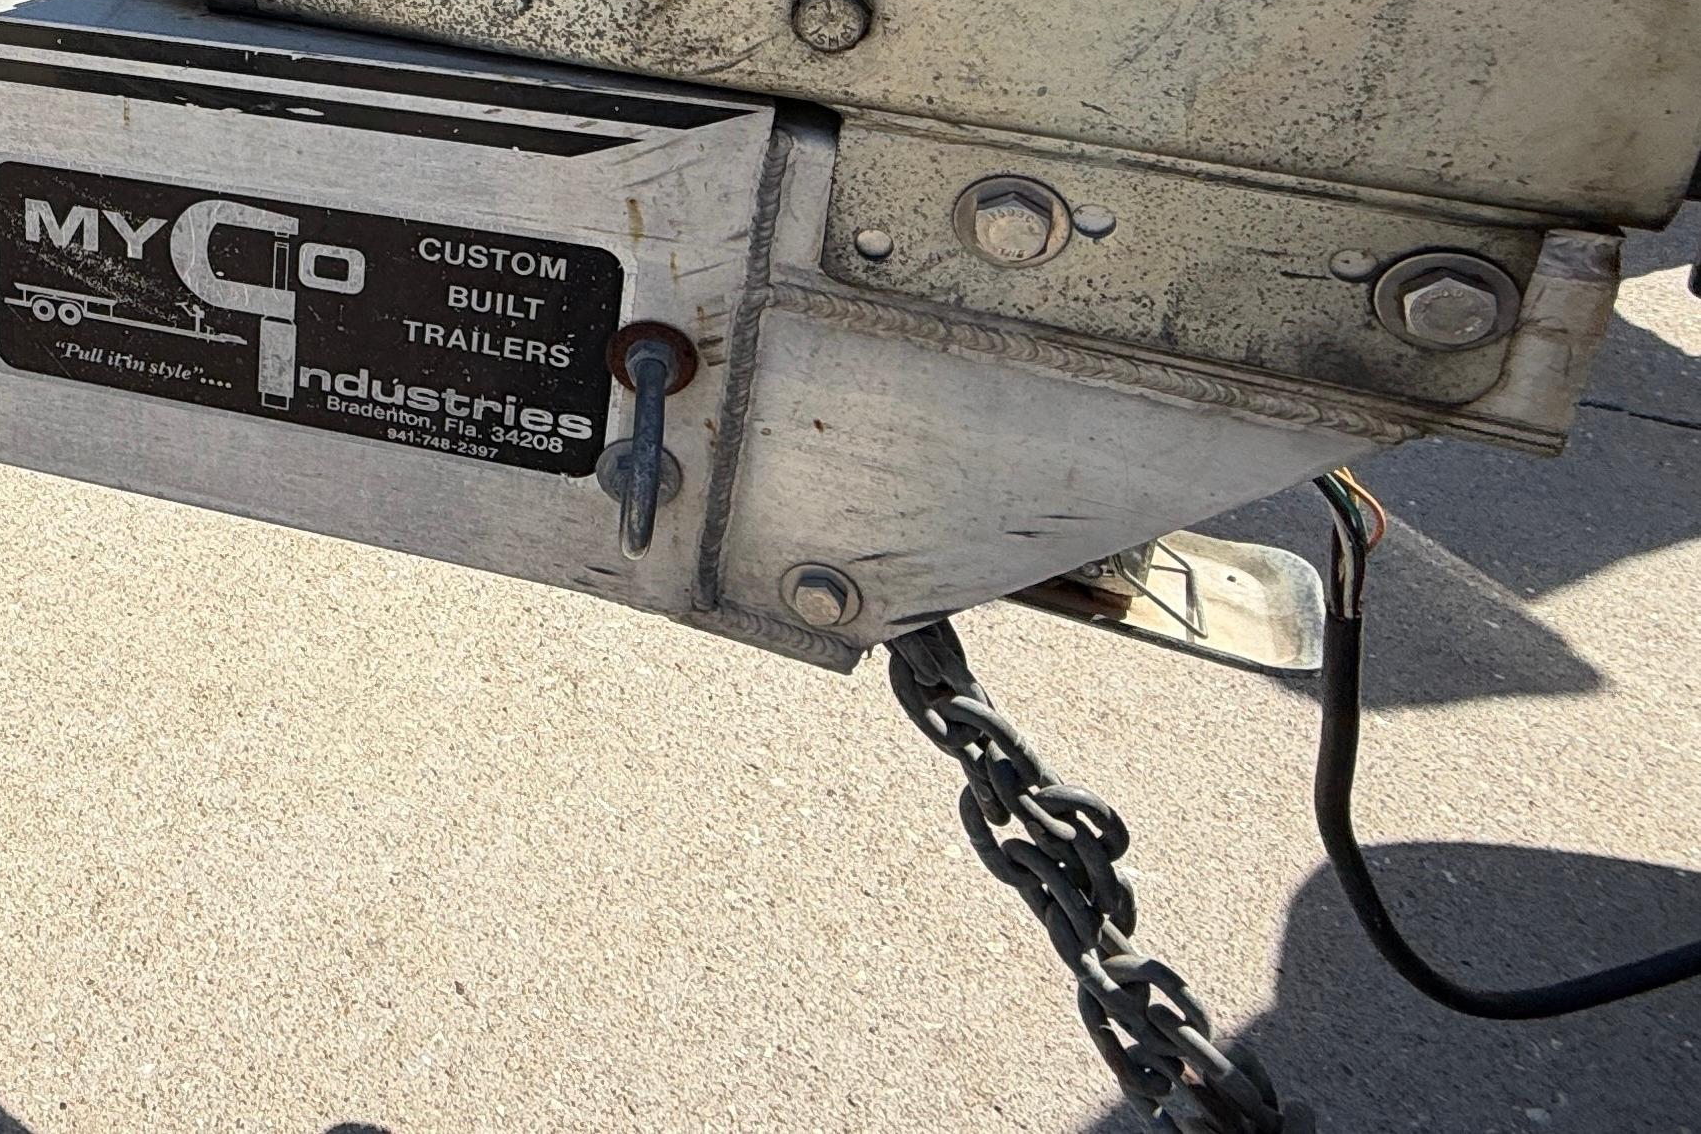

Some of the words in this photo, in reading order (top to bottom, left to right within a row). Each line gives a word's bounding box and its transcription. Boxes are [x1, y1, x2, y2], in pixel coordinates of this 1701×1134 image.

[418, 237, 568, 281] CUSTOM
[448, 285, 545, 320] BUILT
[403, 320, 571, 368] TRAILERS
[326, 395, 437, 433] Bradenton,
[444, 417, 483, 439] Fla.
[490, 426, 564, 454] 34208
[387, 427, 499, 459] 941-748-2397
